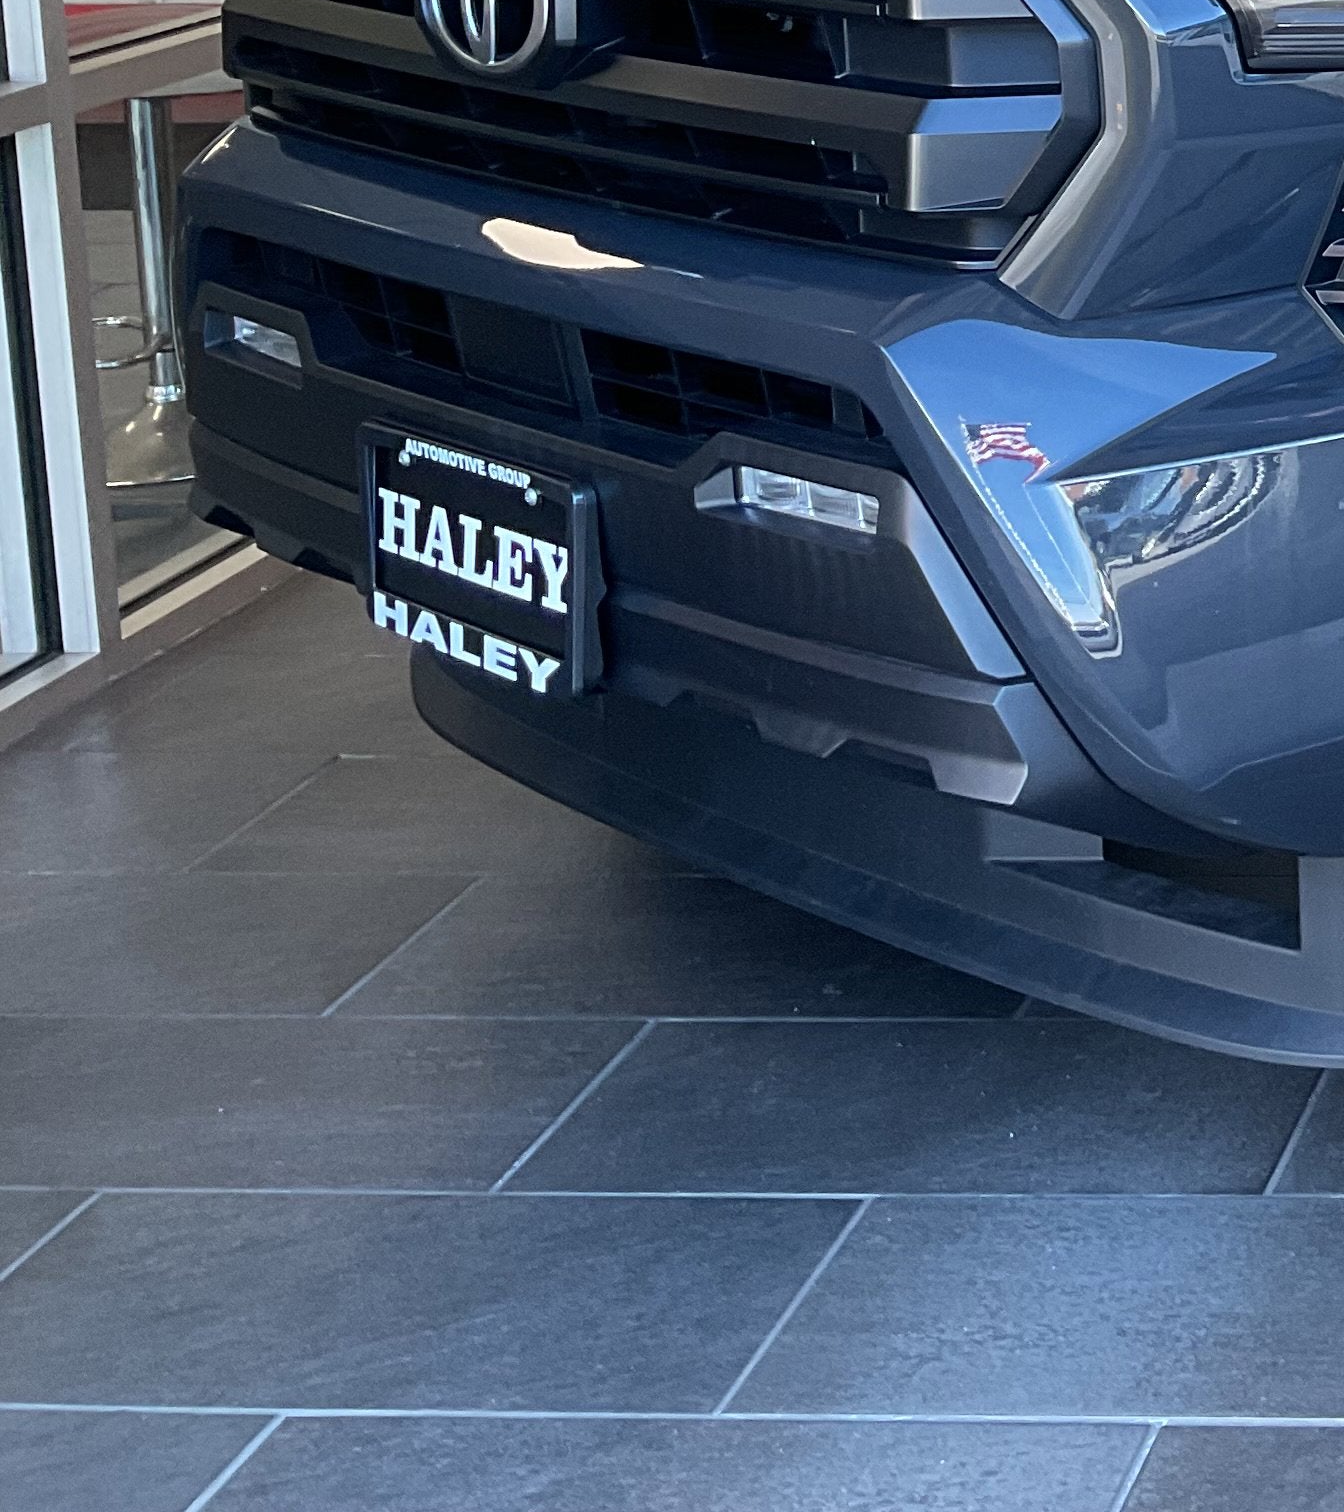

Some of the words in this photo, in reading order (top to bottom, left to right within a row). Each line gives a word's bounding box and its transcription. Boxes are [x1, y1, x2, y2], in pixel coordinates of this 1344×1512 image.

[404, 437, 487, 477] AUTOMOTIVE
[487, 463, 531, 489] GROUP
[378, 486, 569, 614] HALEY
[373, 590, 561, 694] HALEY
